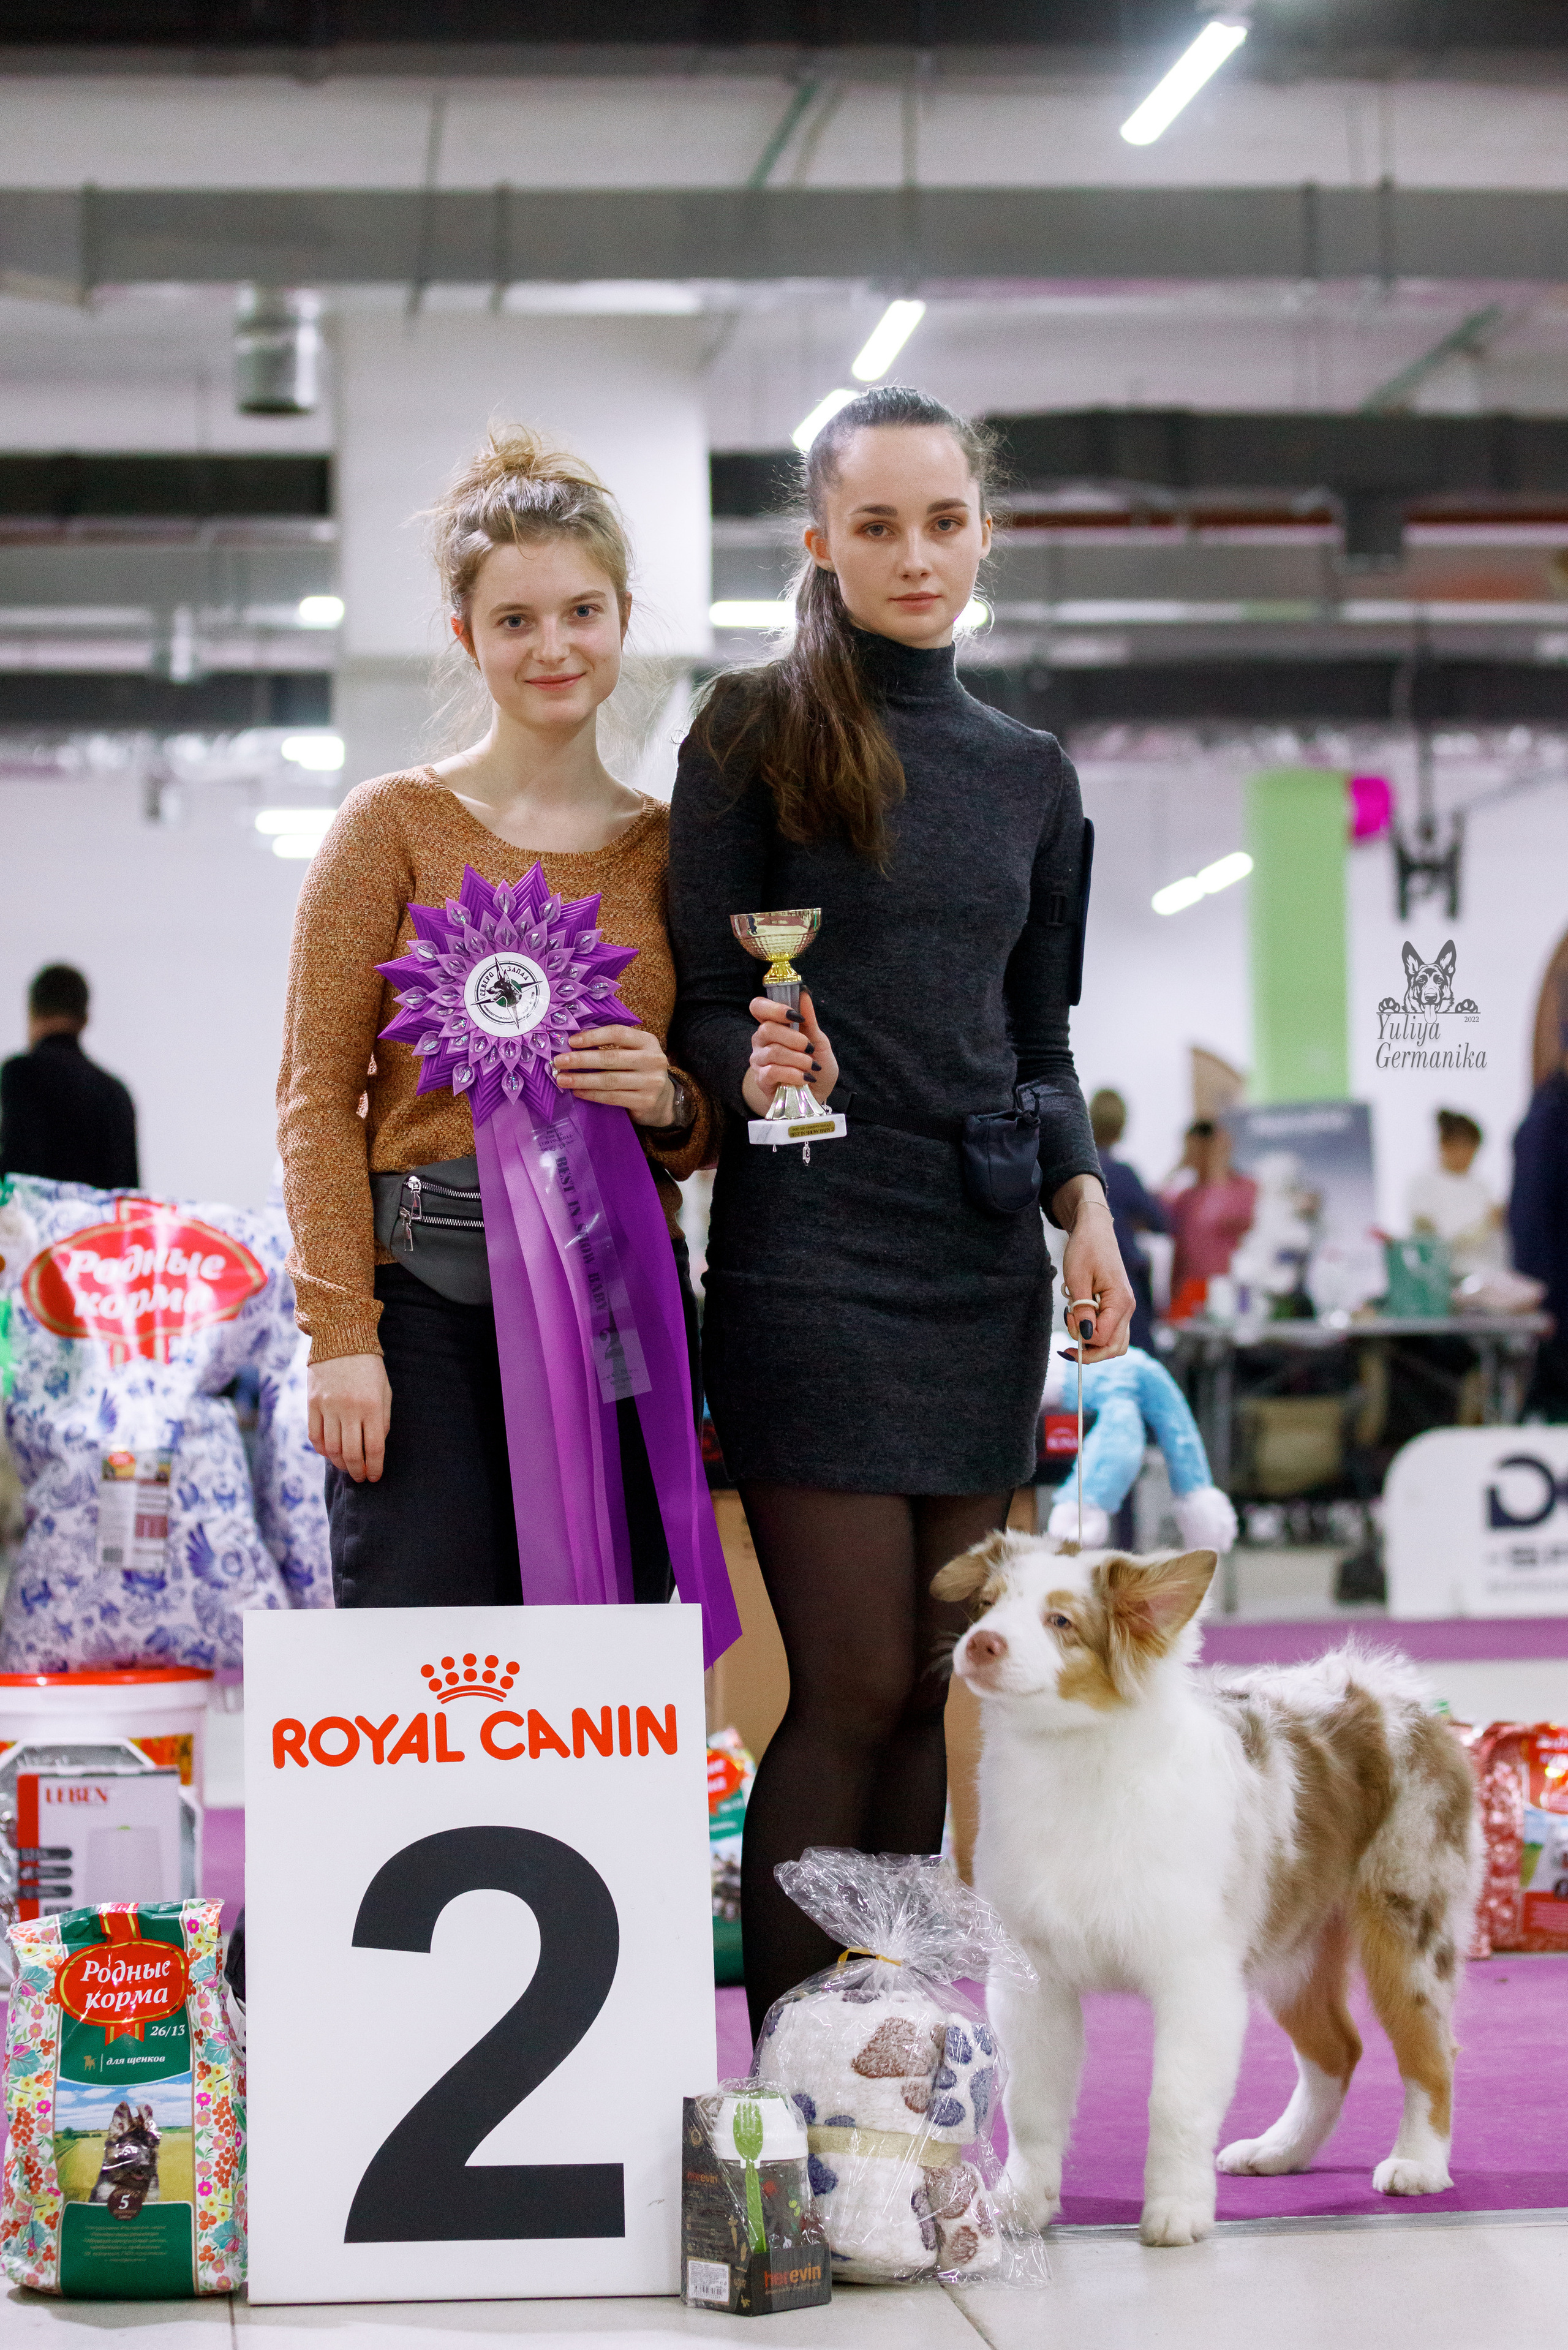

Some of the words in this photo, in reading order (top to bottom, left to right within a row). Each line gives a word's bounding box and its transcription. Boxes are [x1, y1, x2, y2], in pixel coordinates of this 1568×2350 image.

[480, 972, 494, 996] СЕВЕРО
[507, 966, 529, 981] ЗАПАД
[556, 1156, 576, 1193] BEST
[568, 1200, 581, 1217] IN
[587, 1272, 608, 1311] BABY
[64, 1245, 226, 1284] Родные
[74, 1284, 216, 1324] корма
[273, 1711, 466, 1769] ROYAL
[480, 1704, 678, 1760] CANIN
[45, 1787, 108, 1804] LEBEN
[80, 1960, 171, 1983] Родные
[85, 1987, 168, 2013] корма
[149, 2025, 186, 2037] 26/13
[344, 1826, 625, 2243] 2
[127, 2055, 165, 2065] щенков
[118, 2194, 130, 2210] 5
[764, 2262, 821, 2288] herevin
